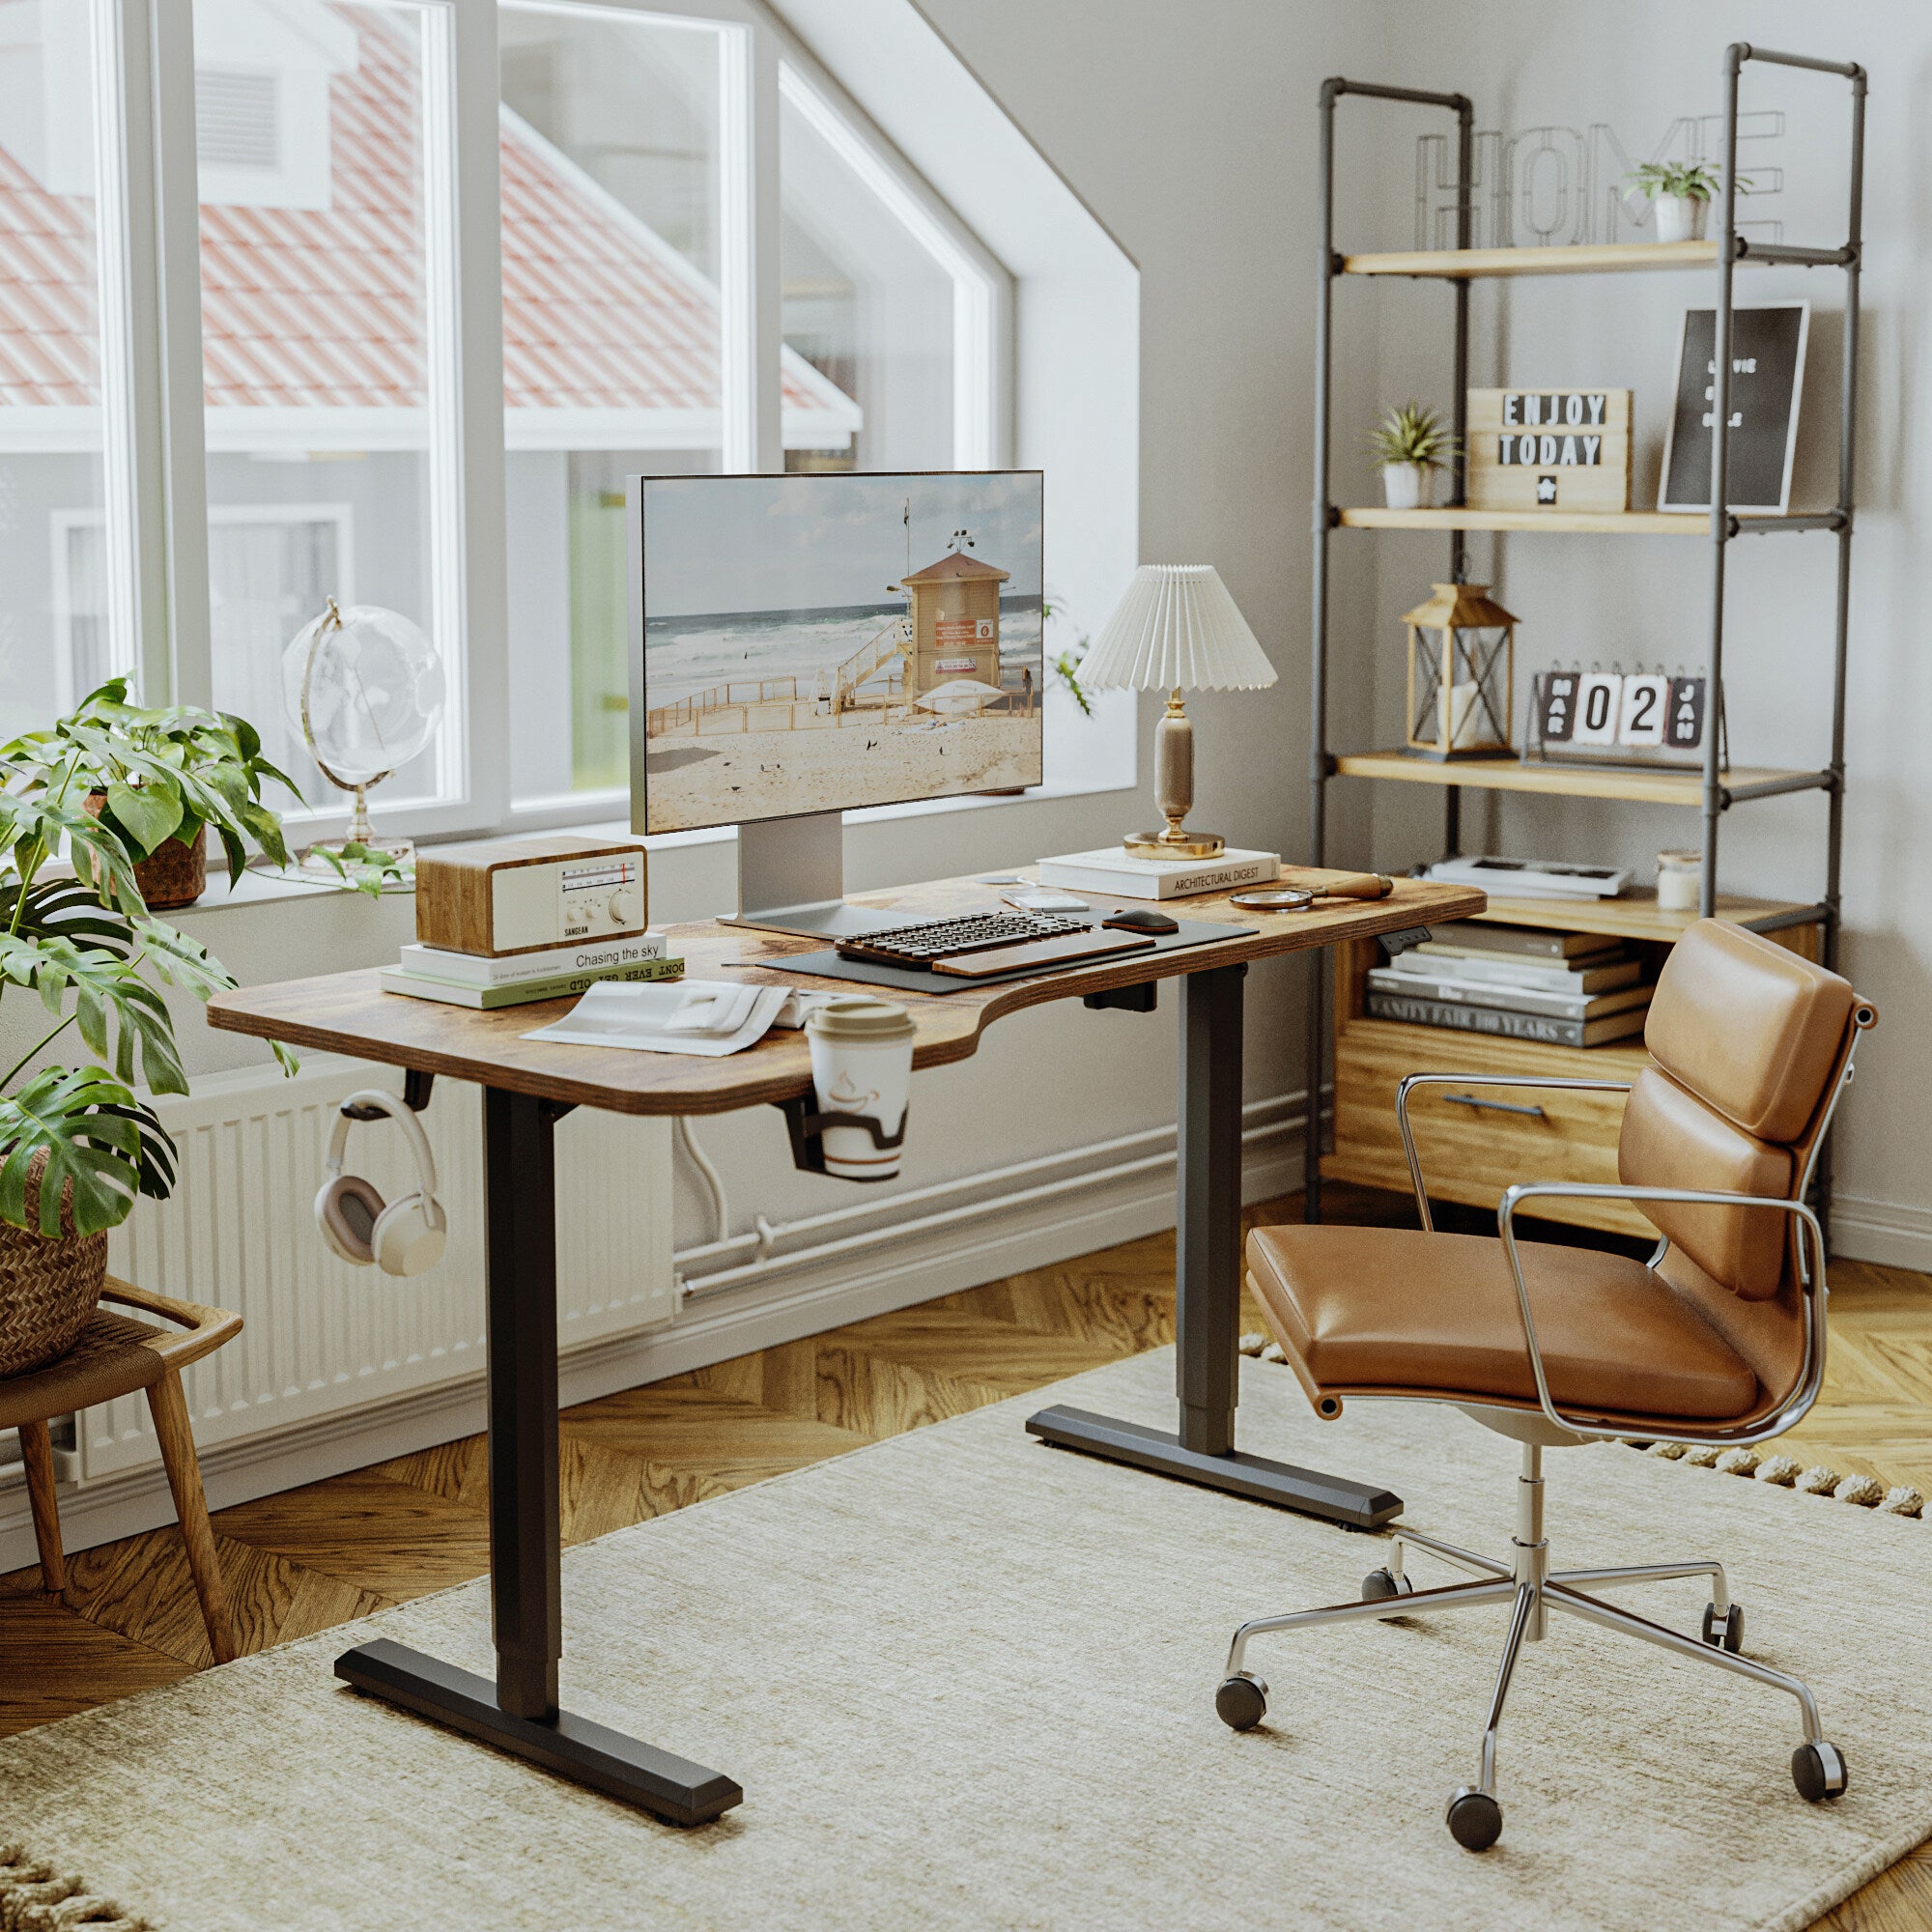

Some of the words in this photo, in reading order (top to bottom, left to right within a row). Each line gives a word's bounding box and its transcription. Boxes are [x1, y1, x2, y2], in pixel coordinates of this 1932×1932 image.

[1415, 110, 1785, 252] HOME
[1504, 393, 1605, 426] ENJOY
[1499, 434, 1600, 466] TODAY
[1548, 679, 1572, 734] MAR
[1676, 684, 1694, 740] JAN
[1175, 873, 1232, 891] ARCHITECTURAL
[1234, 867, 1259, 881] DIGEST
[565, 926, 588, 937] SANGEAN
[576, 949, 619, 968] Chasing
[622, 948, 639, 960] the
[640, 945, 659, 961] sky
[625, 969, 652, 982] EVER
[659, 962, 685, 976] DONT
[570, 978, 591, 991] OLD
